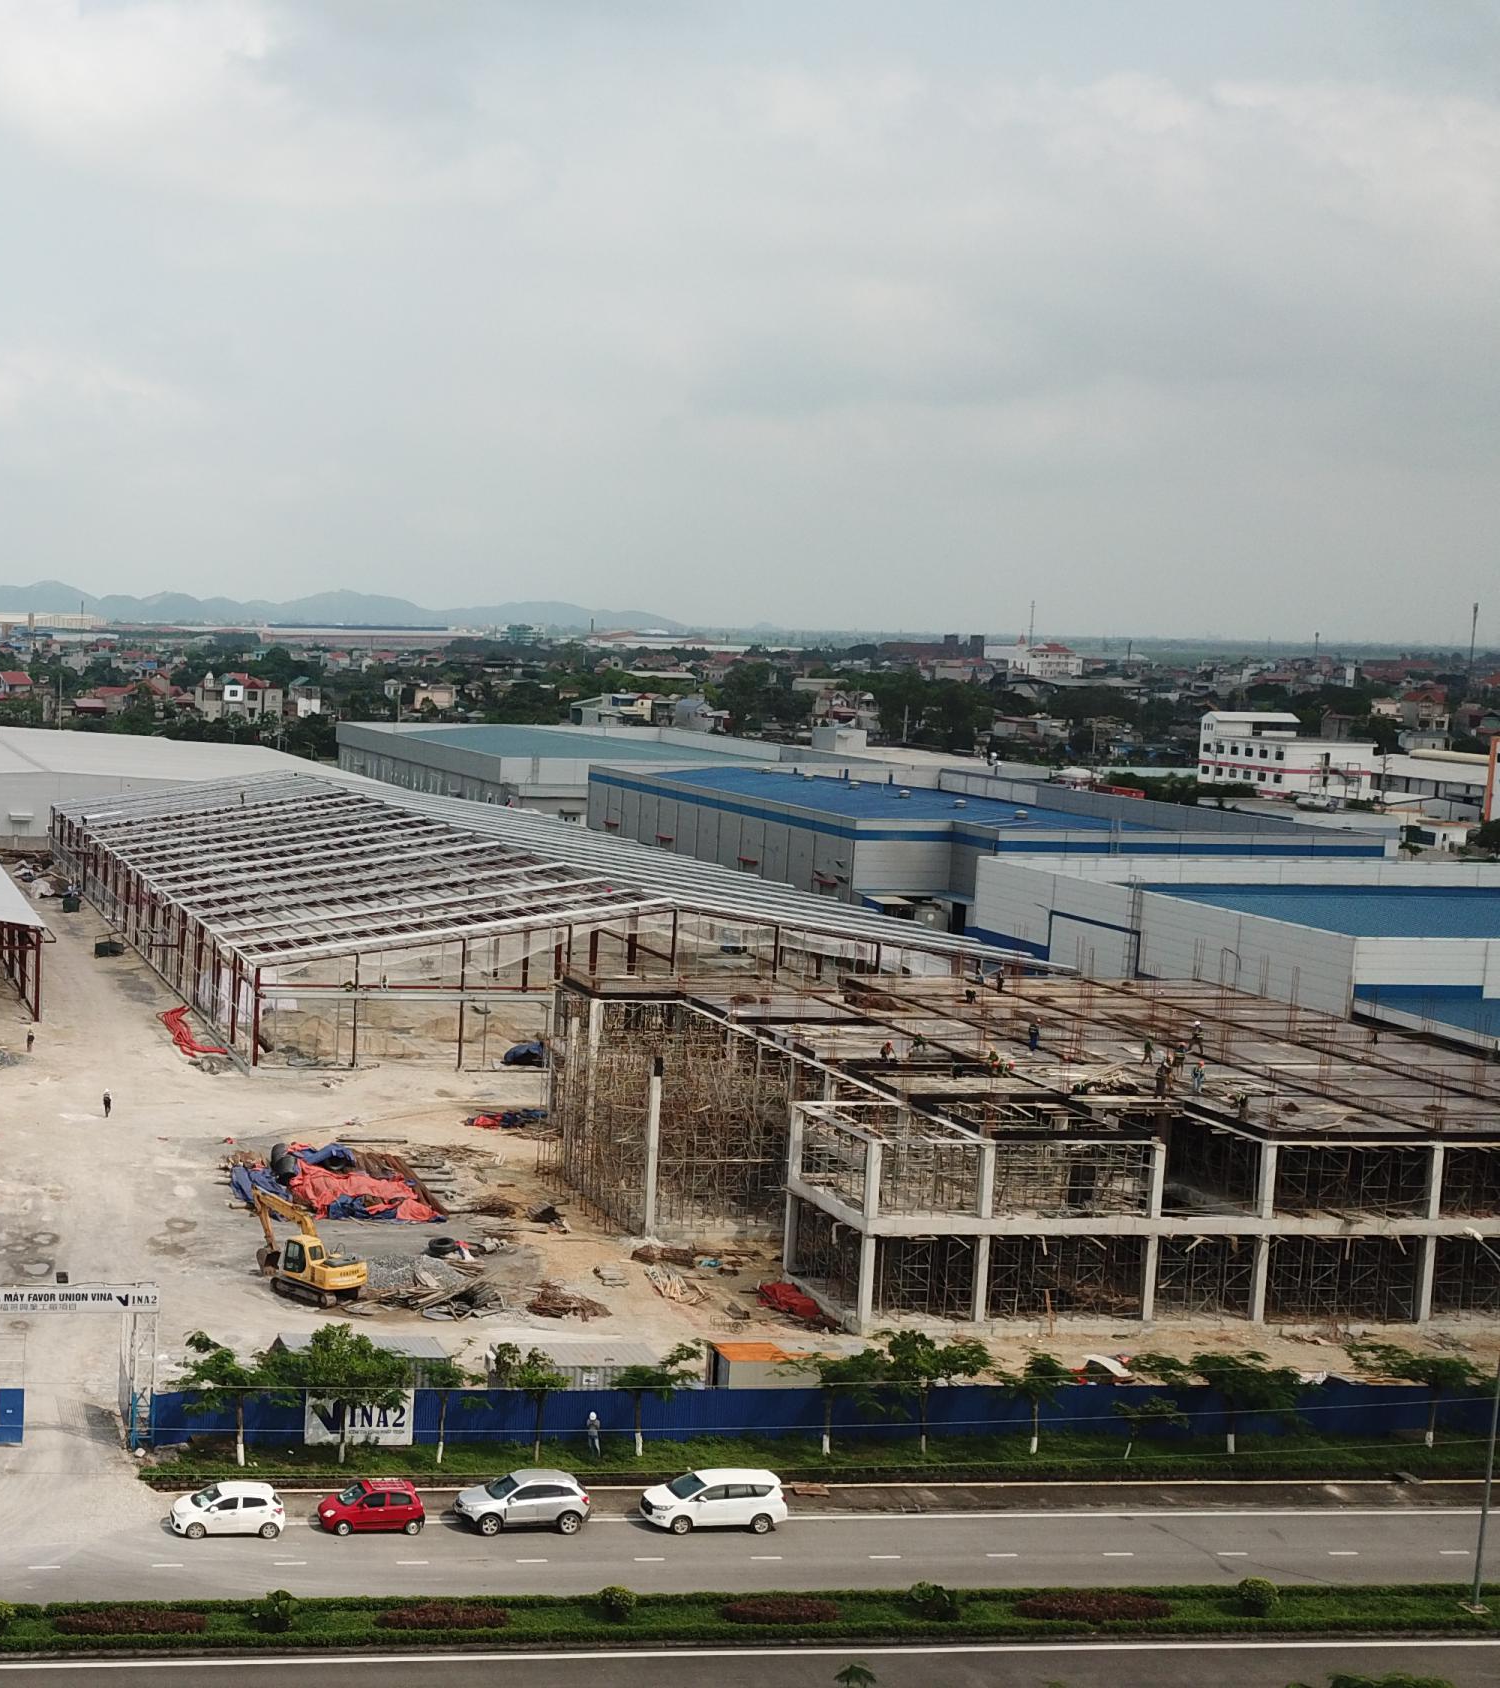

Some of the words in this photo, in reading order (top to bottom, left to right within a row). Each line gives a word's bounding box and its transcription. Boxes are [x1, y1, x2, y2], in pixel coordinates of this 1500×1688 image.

[28, 1292, 56, 1302] FAVOR
[59, 1292, 88, 1302] UNION
[91, 1292, 113, 1302] VINA
